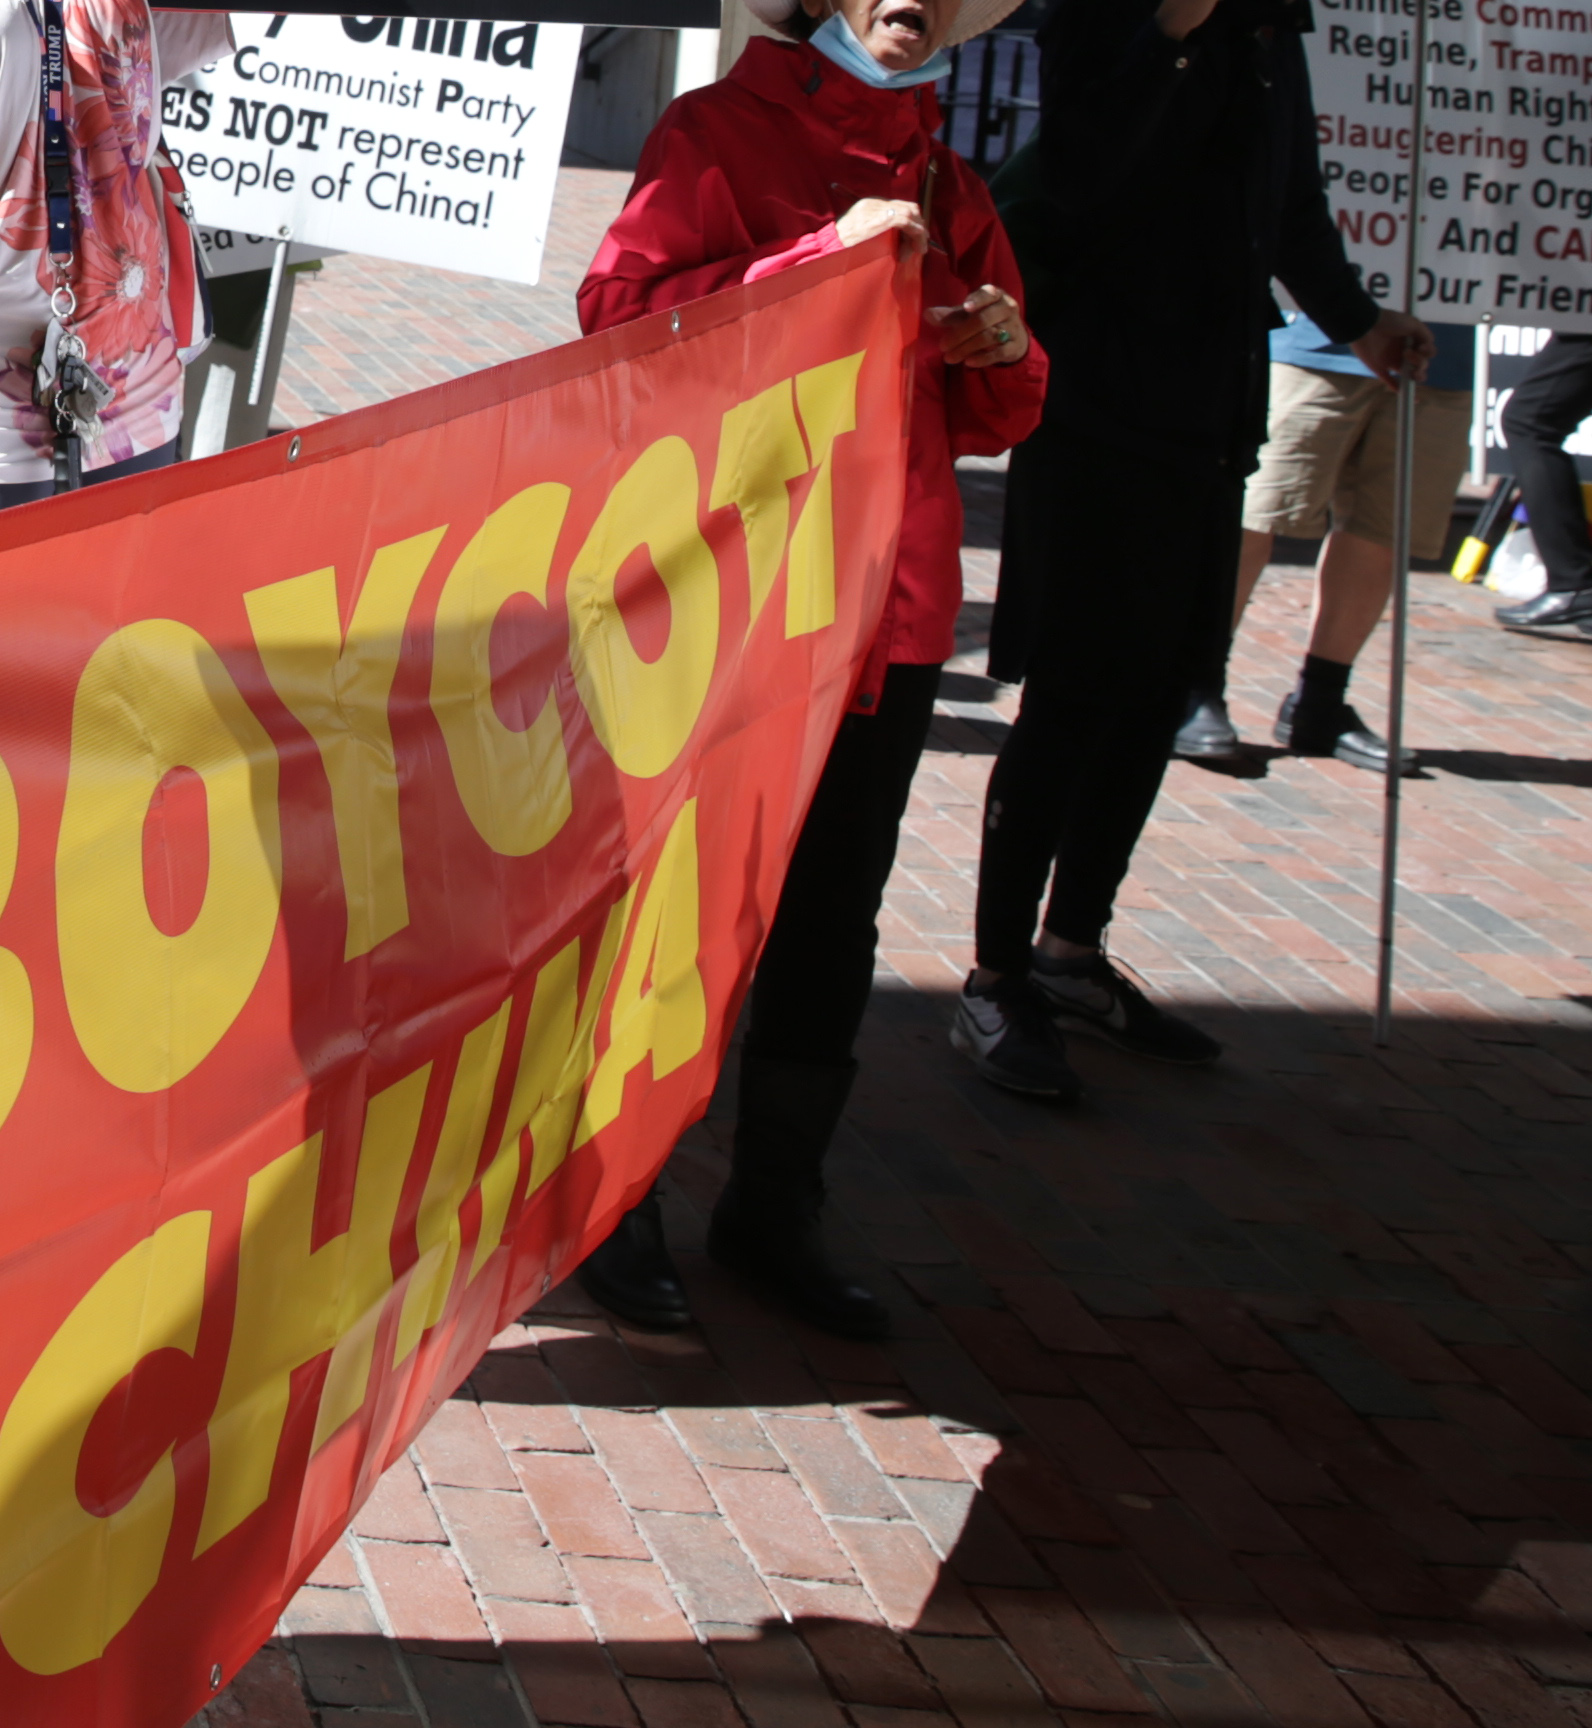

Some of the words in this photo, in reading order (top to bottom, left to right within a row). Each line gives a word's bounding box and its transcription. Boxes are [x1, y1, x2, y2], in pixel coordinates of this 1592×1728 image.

[47, 24, 62, 84] TRUMP
[232, 44, 425, 110] Communist
[435, 76, 537, 138] Party
[1366, 72, 1494, 115] Human
[1507, 84, 1592, 129] Righ
[160, 85, 214, 133] ES
[222, 95, 329, 152] NOT
[337, 124, 527, 182] represent
[311, 161, 355, 203] of
[364, 170, 495, 229] China!
[1322, 160, 1449, 205] Peope
[1462, 170, 1521, 206] For
[1438, 217, 1520, 257] And
[1532, 224, 1592, 263] CA
